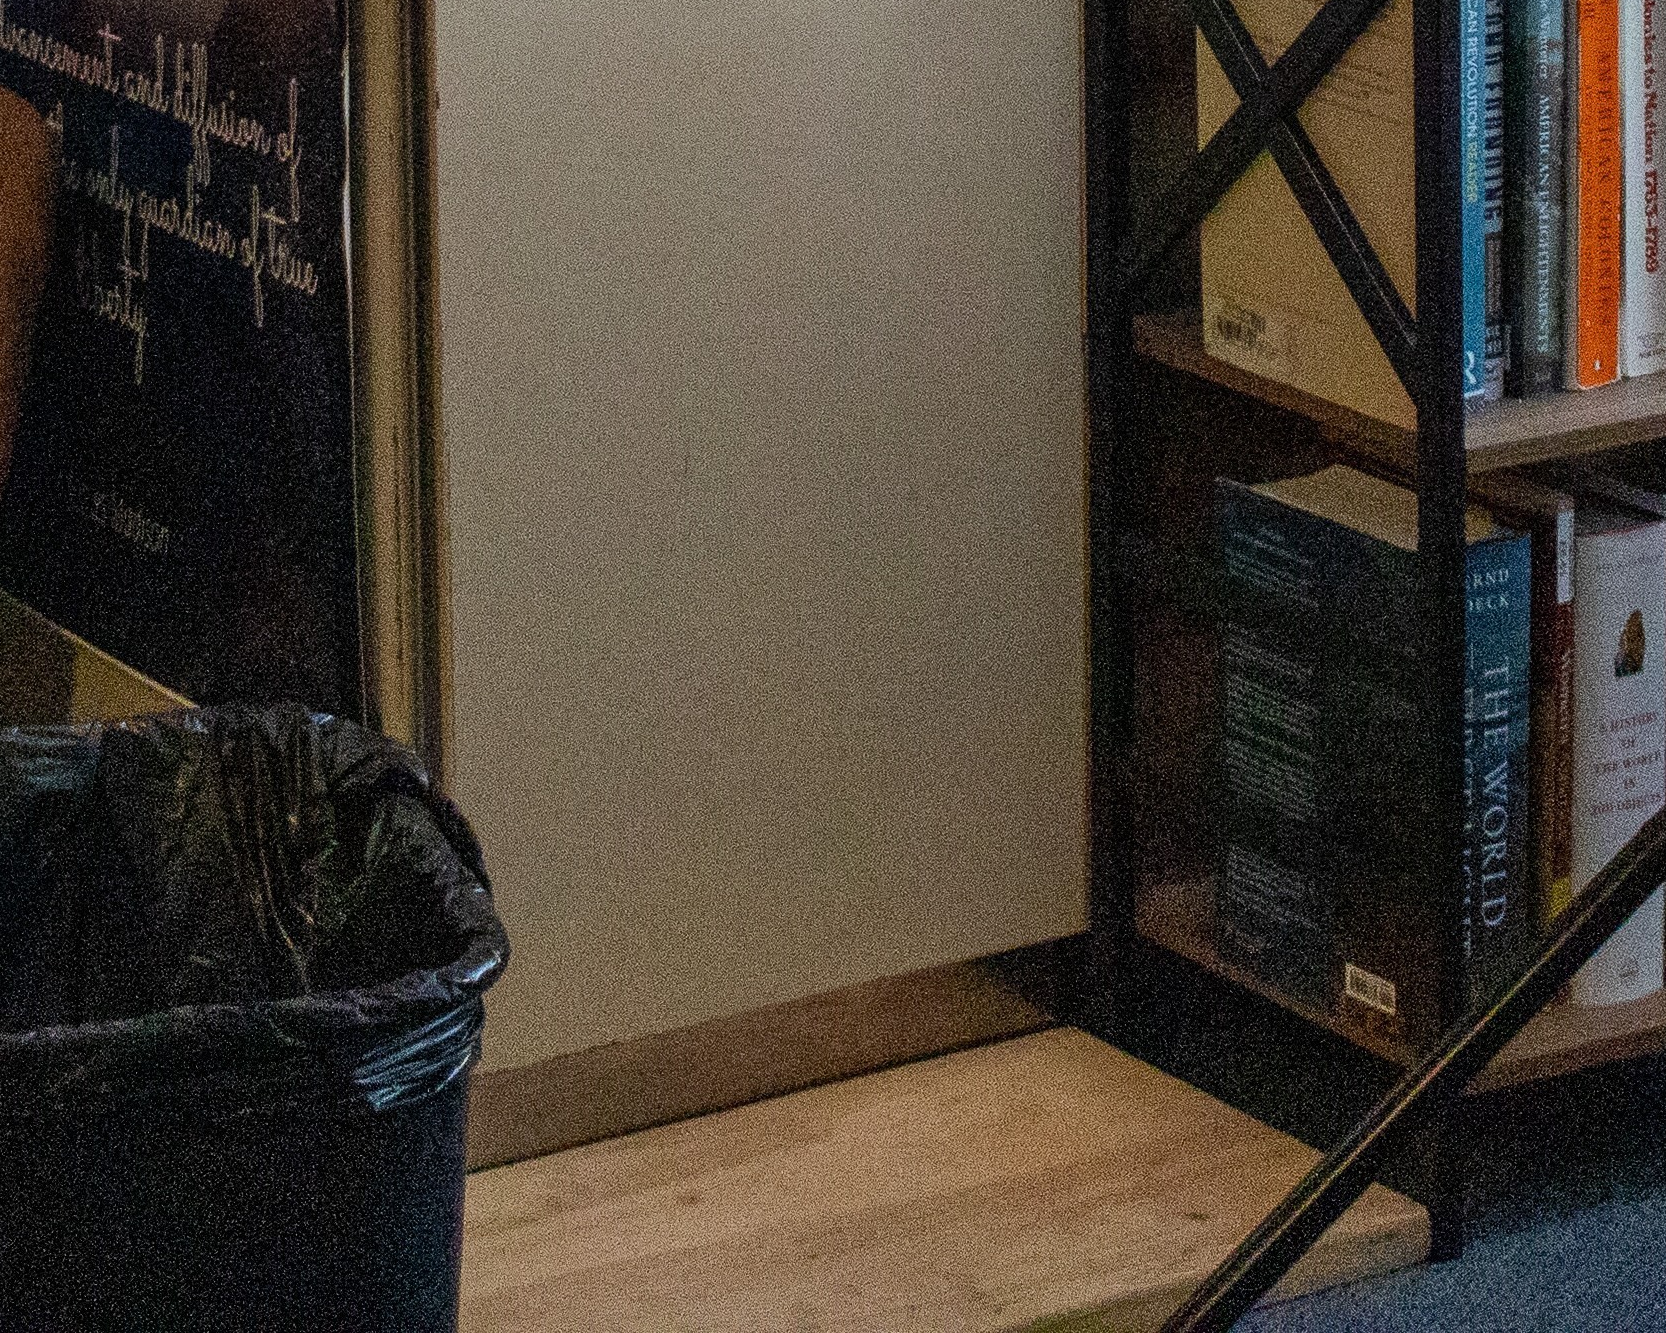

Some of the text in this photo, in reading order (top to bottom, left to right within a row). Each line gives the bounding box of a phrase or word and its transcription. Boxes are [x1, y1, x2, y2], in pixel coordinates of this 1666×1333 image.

[124, 34, 169, 114] and
[1467, 36, 1481, 139] REVOLUTION
[1644, 67, 1657, 90] to
[1537, 94, 1551, 186] AMERICAN
[1644, 91, 1658, 164] Nation
[1468, 142, 1480, 203] READER
[1481, 655, 1510, 929] THE WORLD
